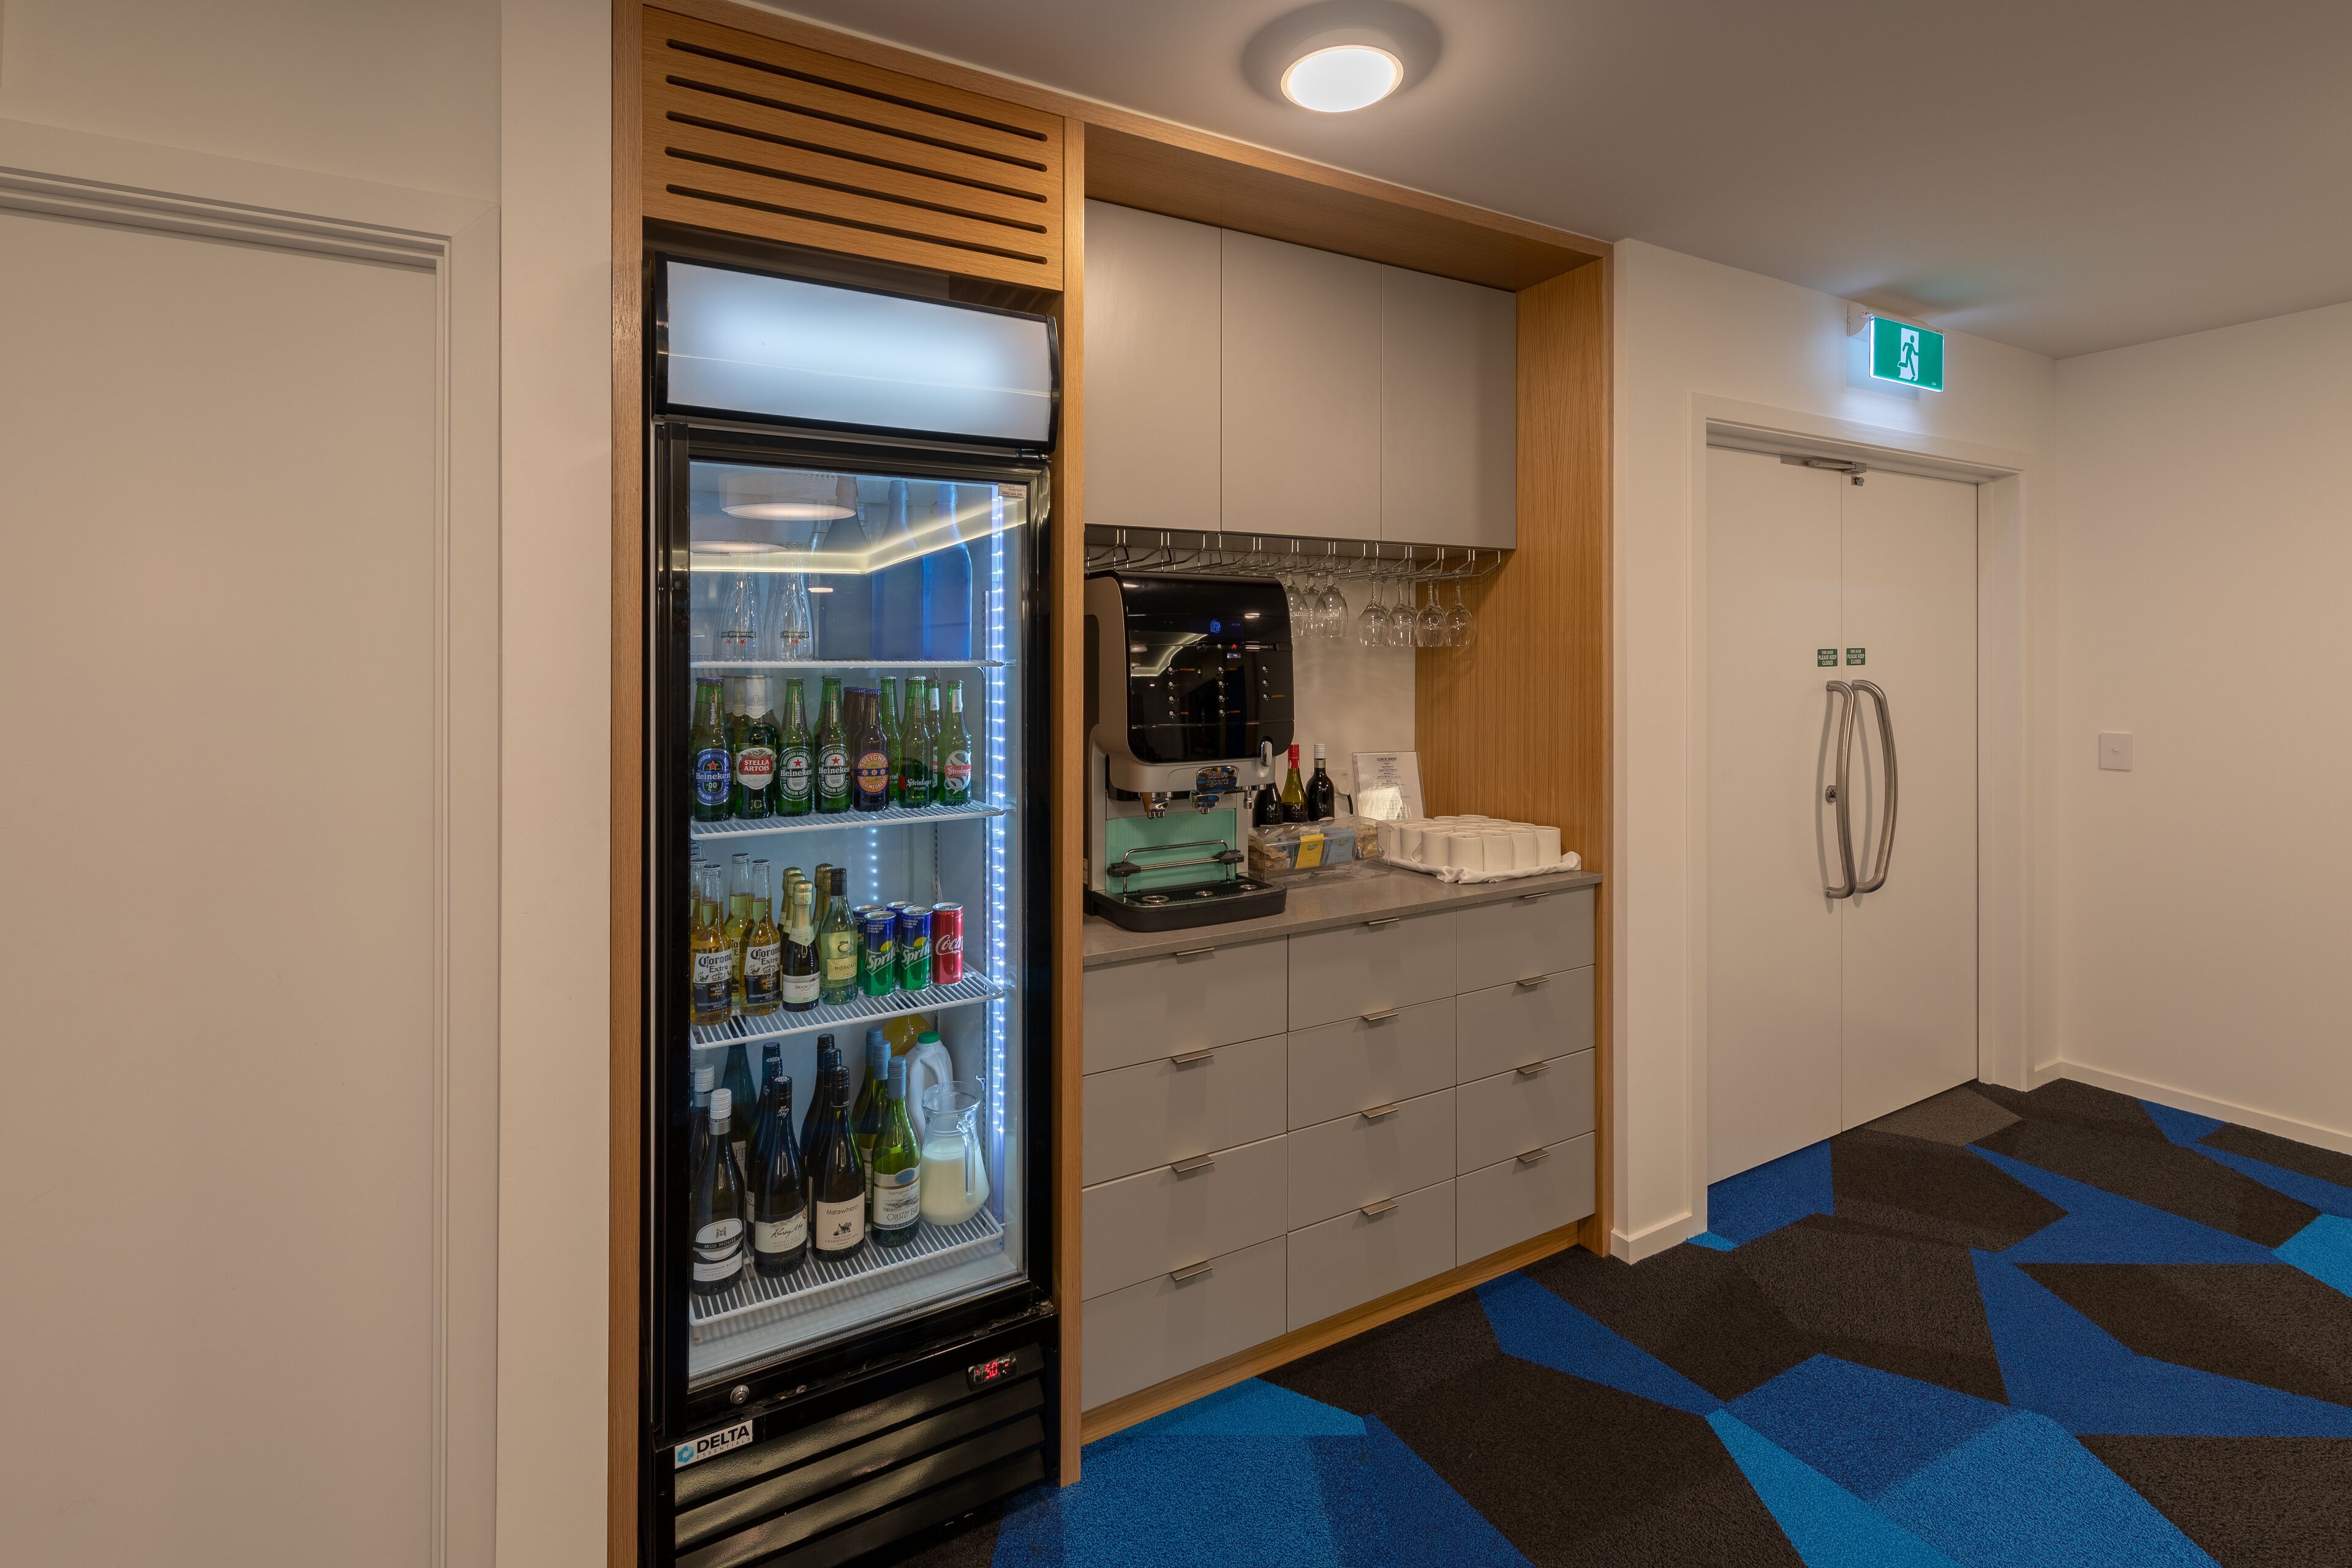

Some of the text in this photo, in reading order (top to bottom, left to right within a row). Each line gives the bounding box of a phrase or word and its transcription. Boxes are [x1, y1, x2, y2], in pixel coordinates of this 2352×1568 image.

[782, 752, 796, 765] HEINEKEN
[820, 749, 834, 763] HEINEKEN
[696, 772, 731, 780] Heineken
[780, 769, 812, 777] Heineken
[821, 780, 849, 793] PREMIUM QUALITY
[907, 774, 932, 788] Steinlager
[697, 787, 712, 801] PREMIUM
[783, 782, 811, 796] PREMIUM QUALITY
[698, 953, 732, 968] Corona
[834, 962, 858, 971] MOSCATO
[709, 965, 728, 973] Extra
[826, 1204, 859, 1215] Matawhero
[718, 1237, 736, 1247] HOUSE
[697, 1425, 750, 1454] DELTA
[696, 1437, 751, 1459] ESSENTIALS
